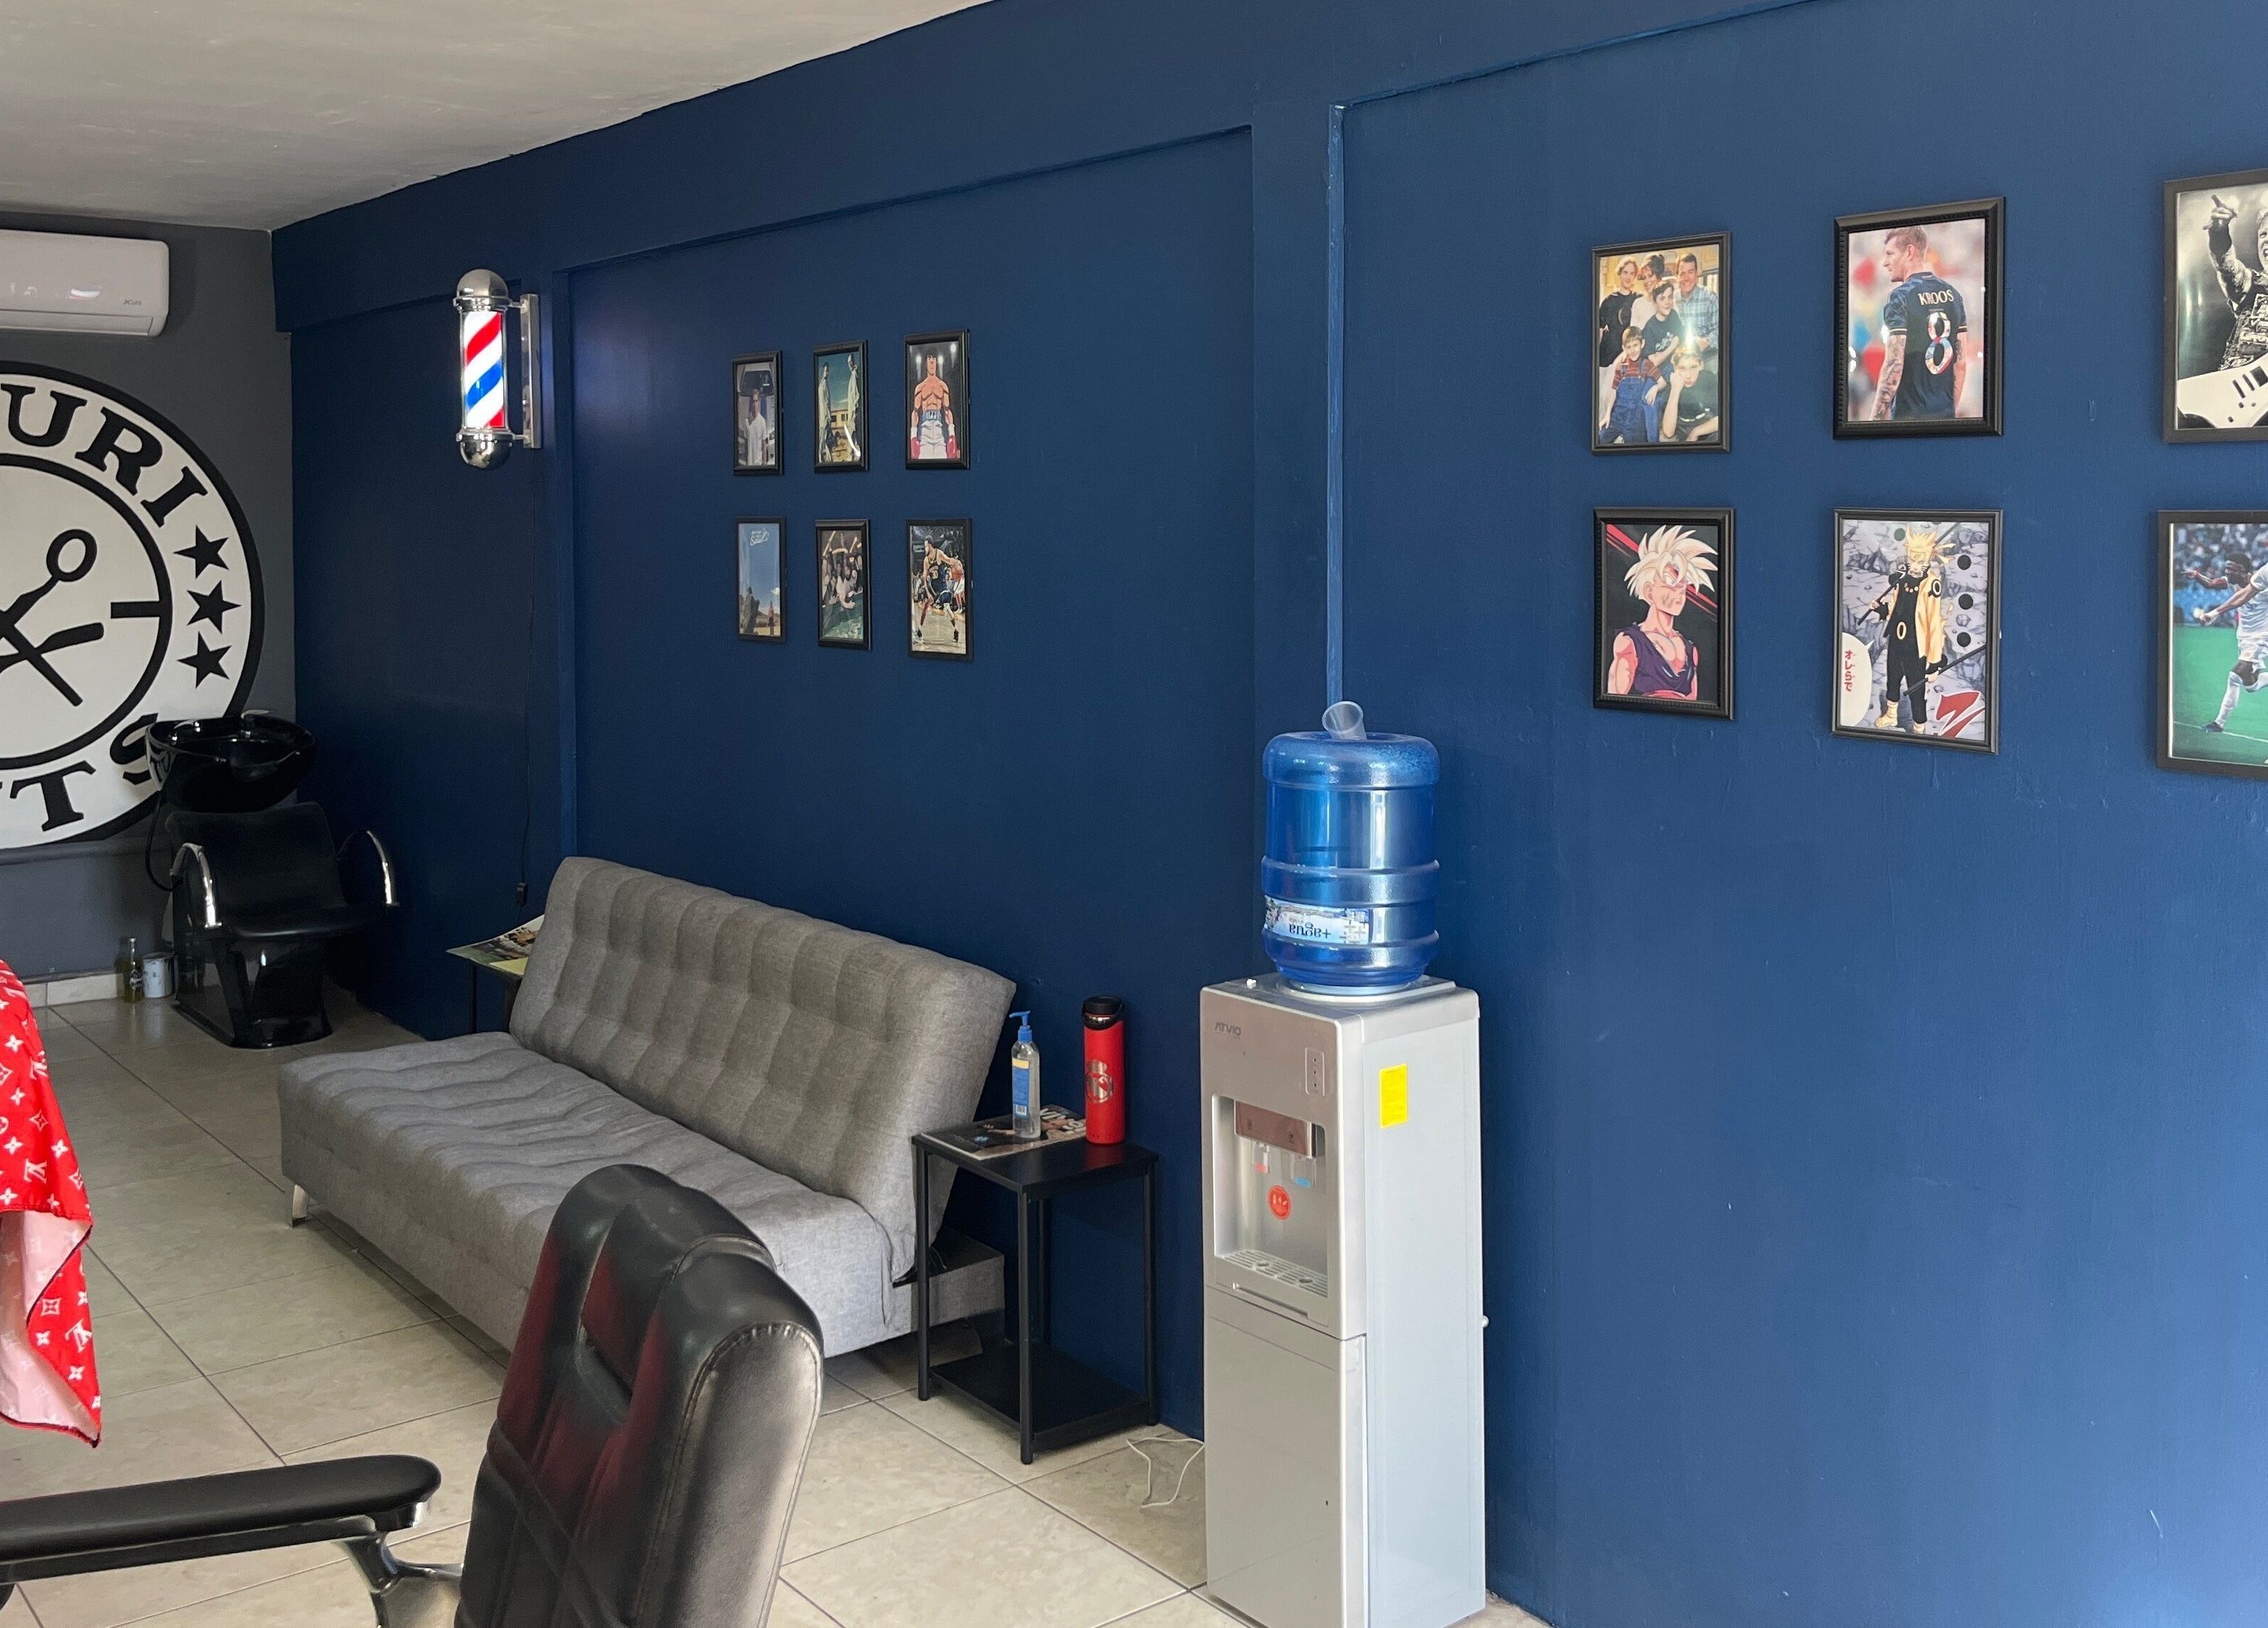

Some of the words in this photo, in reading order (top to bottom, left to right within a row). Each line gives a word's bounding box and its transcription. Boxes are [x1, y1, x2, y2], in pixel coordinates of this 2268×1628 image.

[1918, 289, 1954, 305] KROOS
[1925, 312, 1952, 374] 8
[1844, 650, 1852, 692] オレらで
[1215, 1021, 1242, 1036] ATVIO
